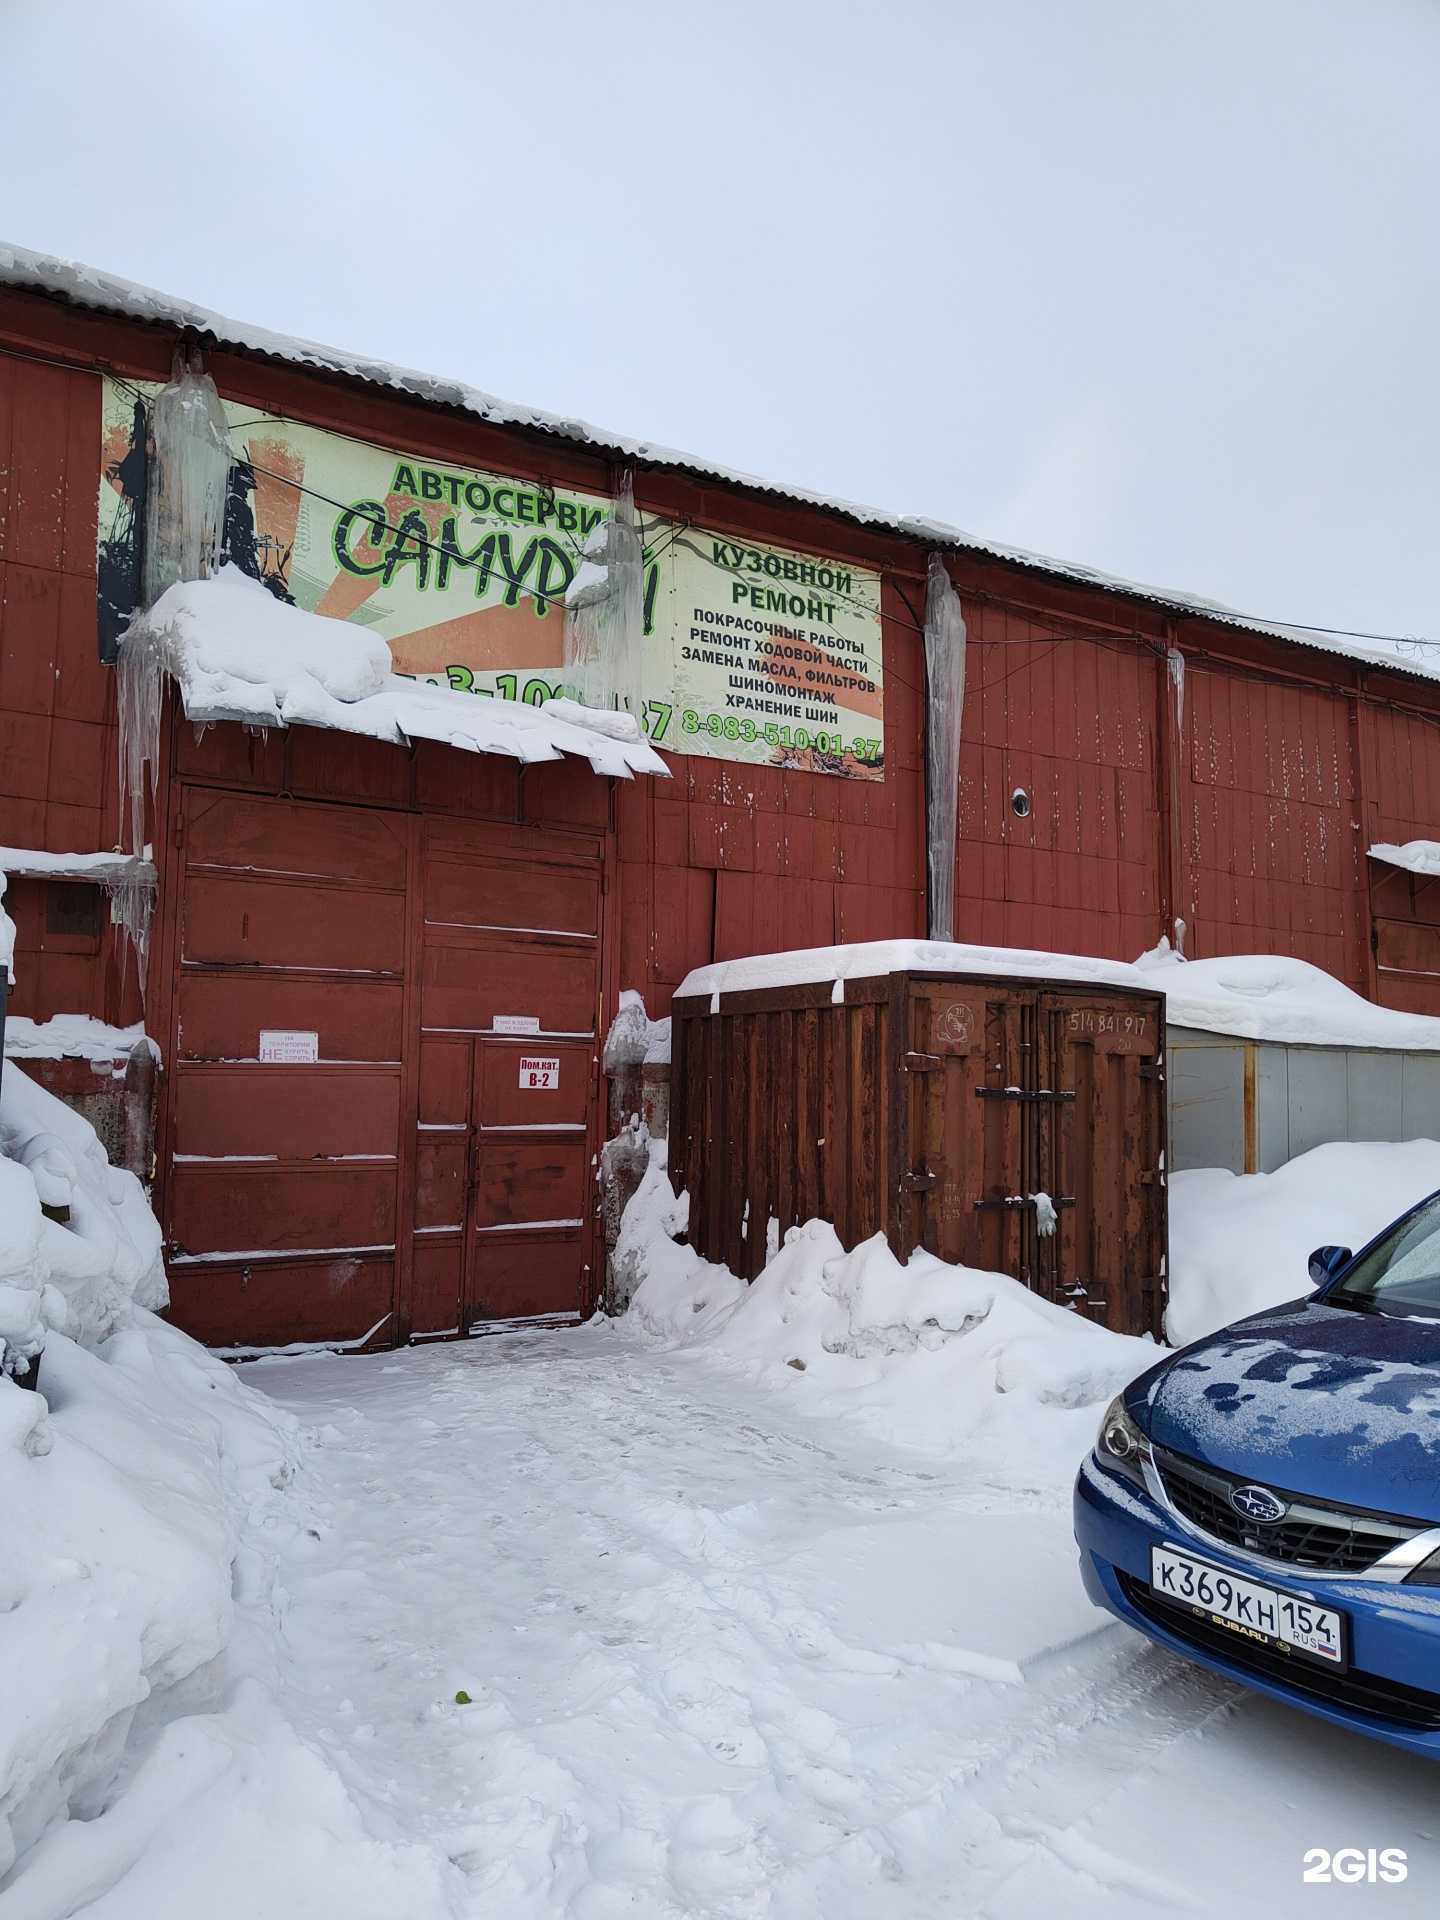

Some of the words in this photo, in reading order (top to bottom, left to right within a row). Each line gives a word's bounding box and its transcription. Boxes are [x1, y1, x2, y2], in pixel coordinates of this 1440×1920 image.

[391, 464, 612, 535] АВТОСЕРВИ
[333, 500, 660, 637] САМУР
[712, 541, 852, 594] КУЗОВНОЙ
[732, 581, 836, 624] РЕМОНТ
[689, 627, 751, 652] РЕМОНТ
[753, 640, 823, 665] ХОДОВОЙ
[826, 655, 868, 674] ЧАСТИ
[693, 608, 806, 641] ПОКРАСОЧНЫЕ
[808, 632, 865, 655] РАБОТЫ
[681, 647, 744, 670] ЗАМЕНА
[748, 659, 801, 682] МАСЛА,
[805, 670, 875, 693] ФИЛЬТРОВ
[728, 674, 836, 704] ШИНОМОНТАЖ
[726, 694, 802, 718] ХРАНЕНИЕ
[806, 709, 838, 725] ШИН
[682, 709, 882, 760] 8-983-510-01-37
[263, 1048, 283, 1060] НЕ
[529, 1073, 550, 1087] В-2
[1211, 1614, 1269, 1644] SUBARU
[1282, 1602, 1331, 1643] 154
[1293, 1631, 1318, 1649] RUS
